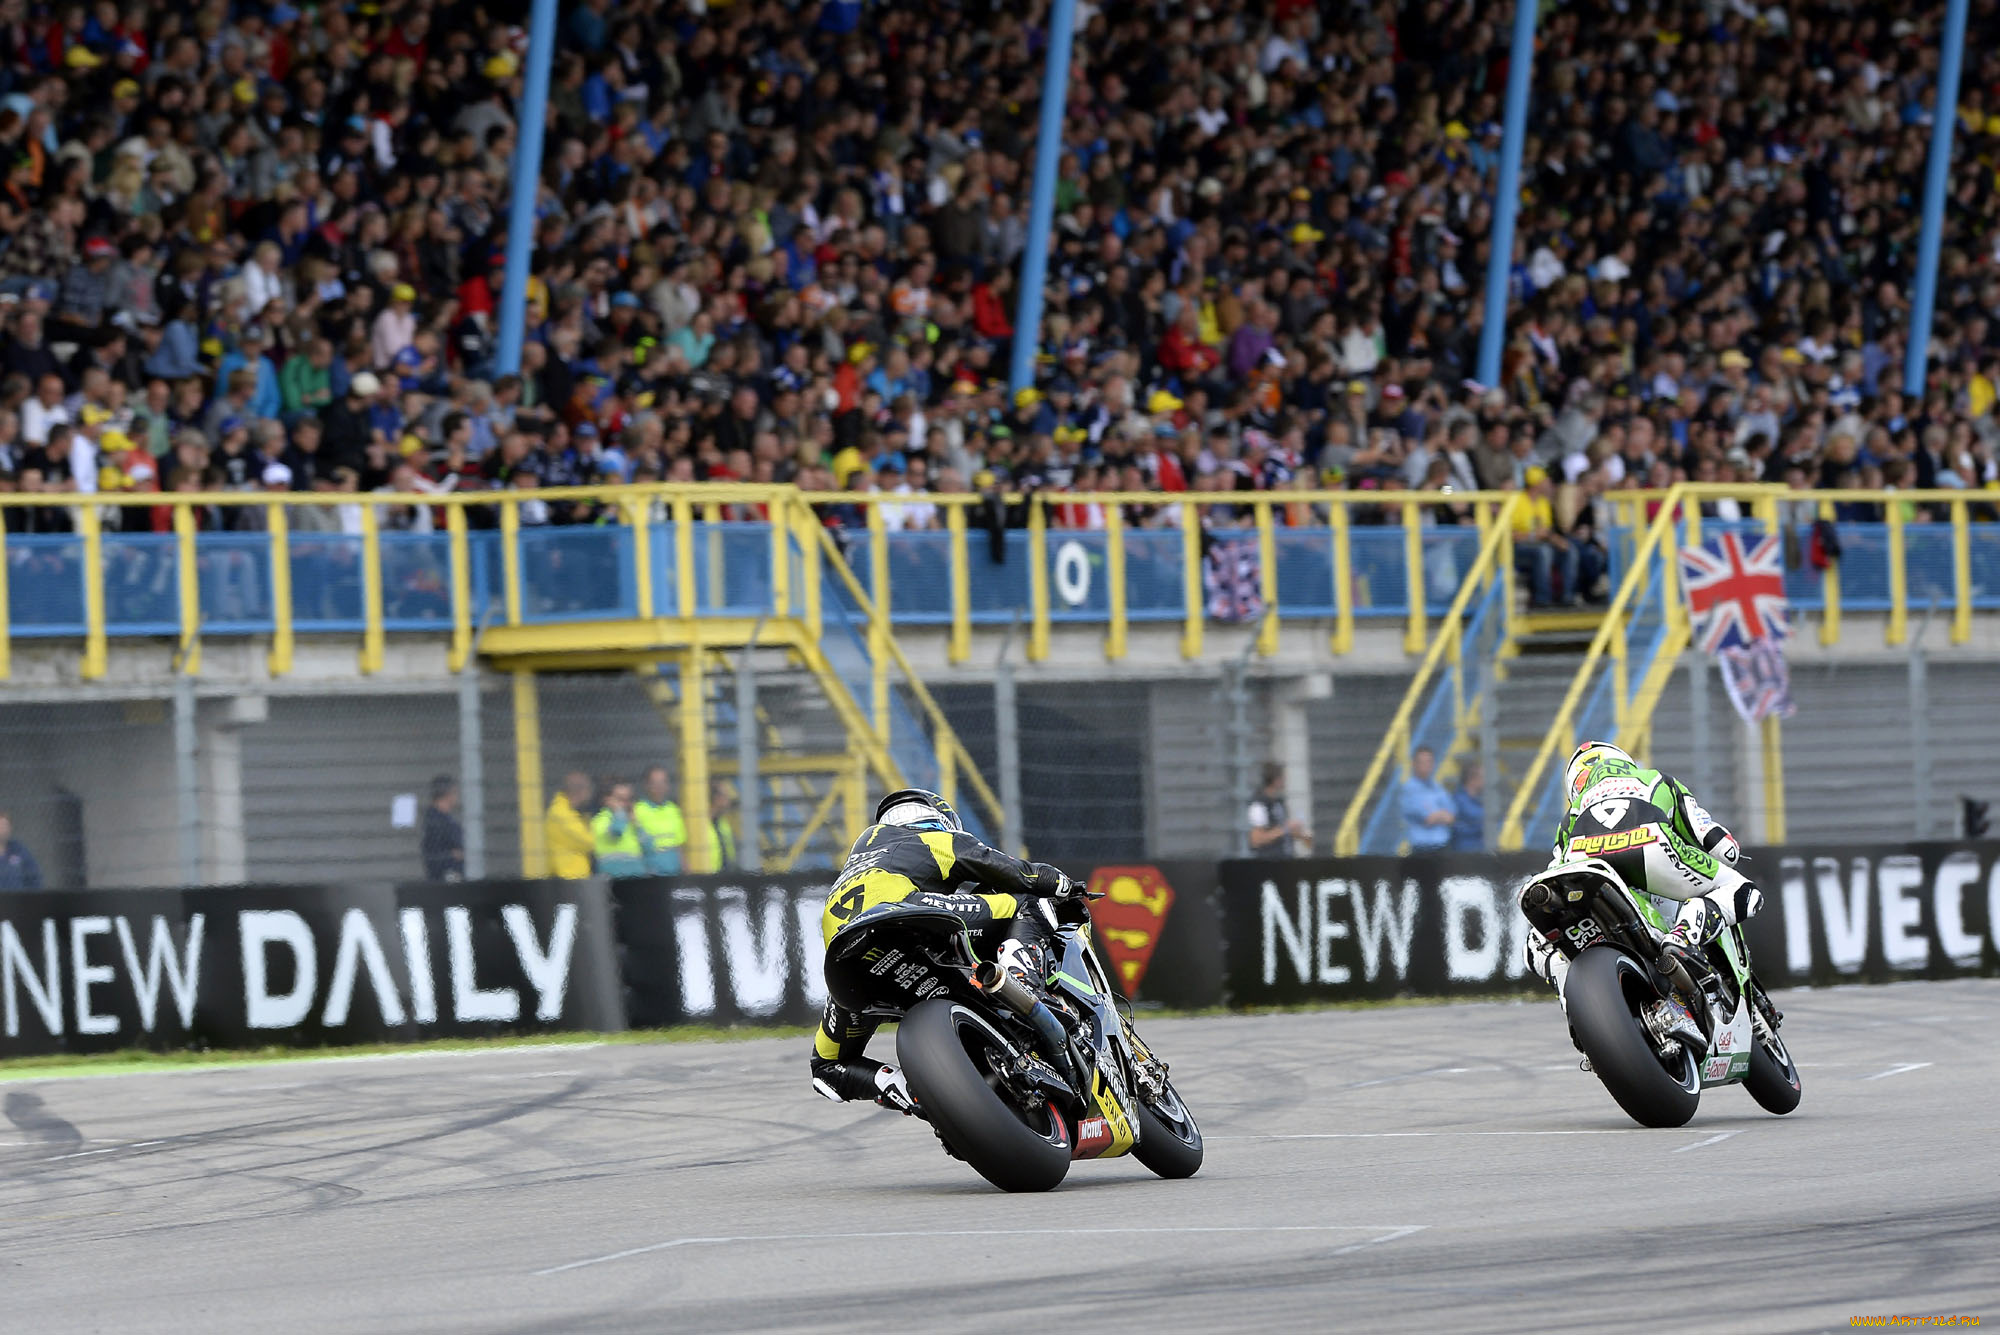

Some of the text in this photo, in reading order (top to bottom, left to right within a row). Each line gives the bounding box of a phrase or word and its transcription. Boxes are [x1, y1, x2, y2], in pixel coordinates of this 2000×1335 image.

[876, 953, 905, 976] YAMAHA
[1260, 876, 1420, 986] NEW
[1780, 851, 2000, 977] IVEC
[0, 903, 578, 1038] NEW DAILY
[1081, 1120, 1103, 1139] MOTUL
